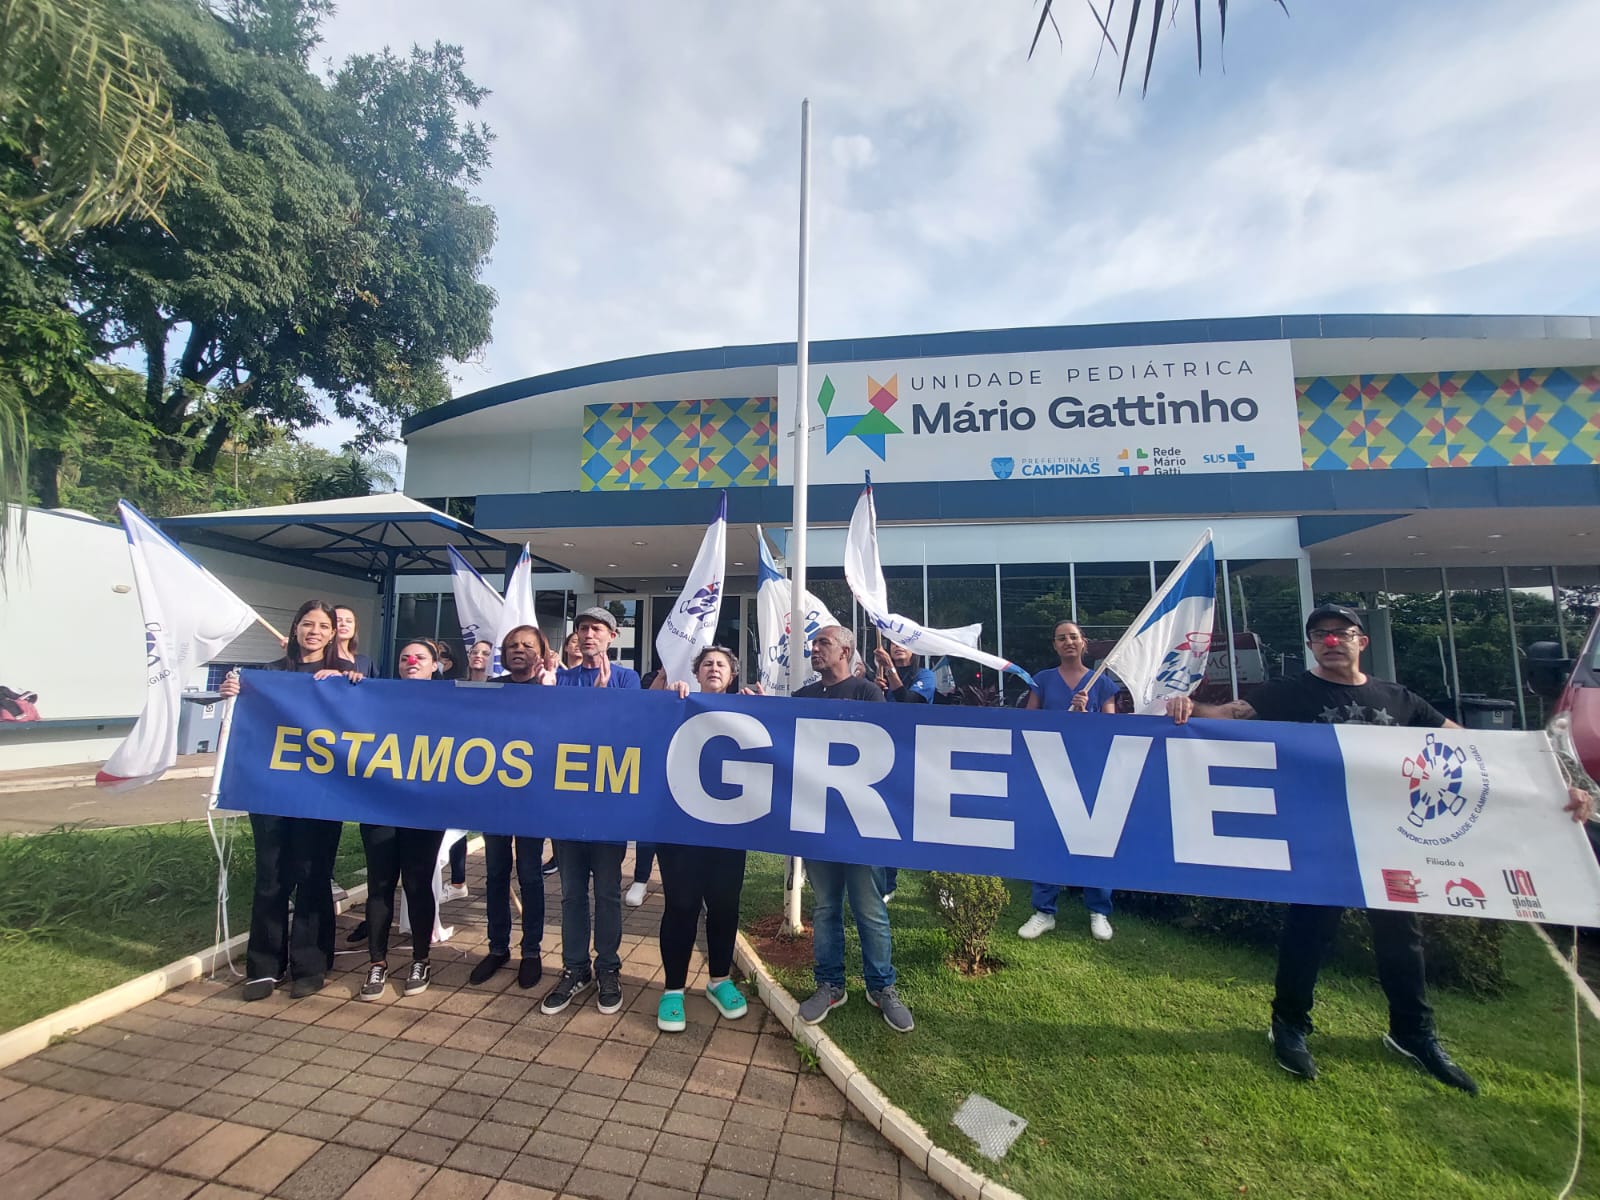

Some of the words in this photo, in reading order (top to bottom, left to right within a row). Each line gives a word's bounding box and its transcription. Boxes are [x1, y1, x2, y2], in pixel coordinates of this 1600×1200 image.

[911, 369, 1042, 391] UNIDADE
[1067, 359, 1253, 383] PEDIÁTRICA
[912, 399, 1036, 435] Mário
[1048, 389, 1259, 430] Gattinho
[1153, 446, 1182, 457] Rede
[1021, 456, 1083, 464] PREFEITURA
[1153, 456, 1187, 467] Mário
[1203, 454, 1226, 464] SUS
[1021, 462, 1101, 477] CAMPINAS
[269, 725, 534, 788] ESTAMOS
[554, 743, 641, 794] EM
[666, 711, 1292, 871] GREVE
[1397, 825, 1440, 846] SINDICATO
[1440, 837, 1453, 845] DA
[1468, 812, 1479, 823] DE
[1474, 778, 1491, 814] CAMPINAS
[1425, 857, 1456, 867] Filiado
[1502, 869, 1537, 897] UNI
[1447, 897, 1488, 910] UGT
[1512, 896, 1542, 909] global
[1515, 909, 1545, 920] union
